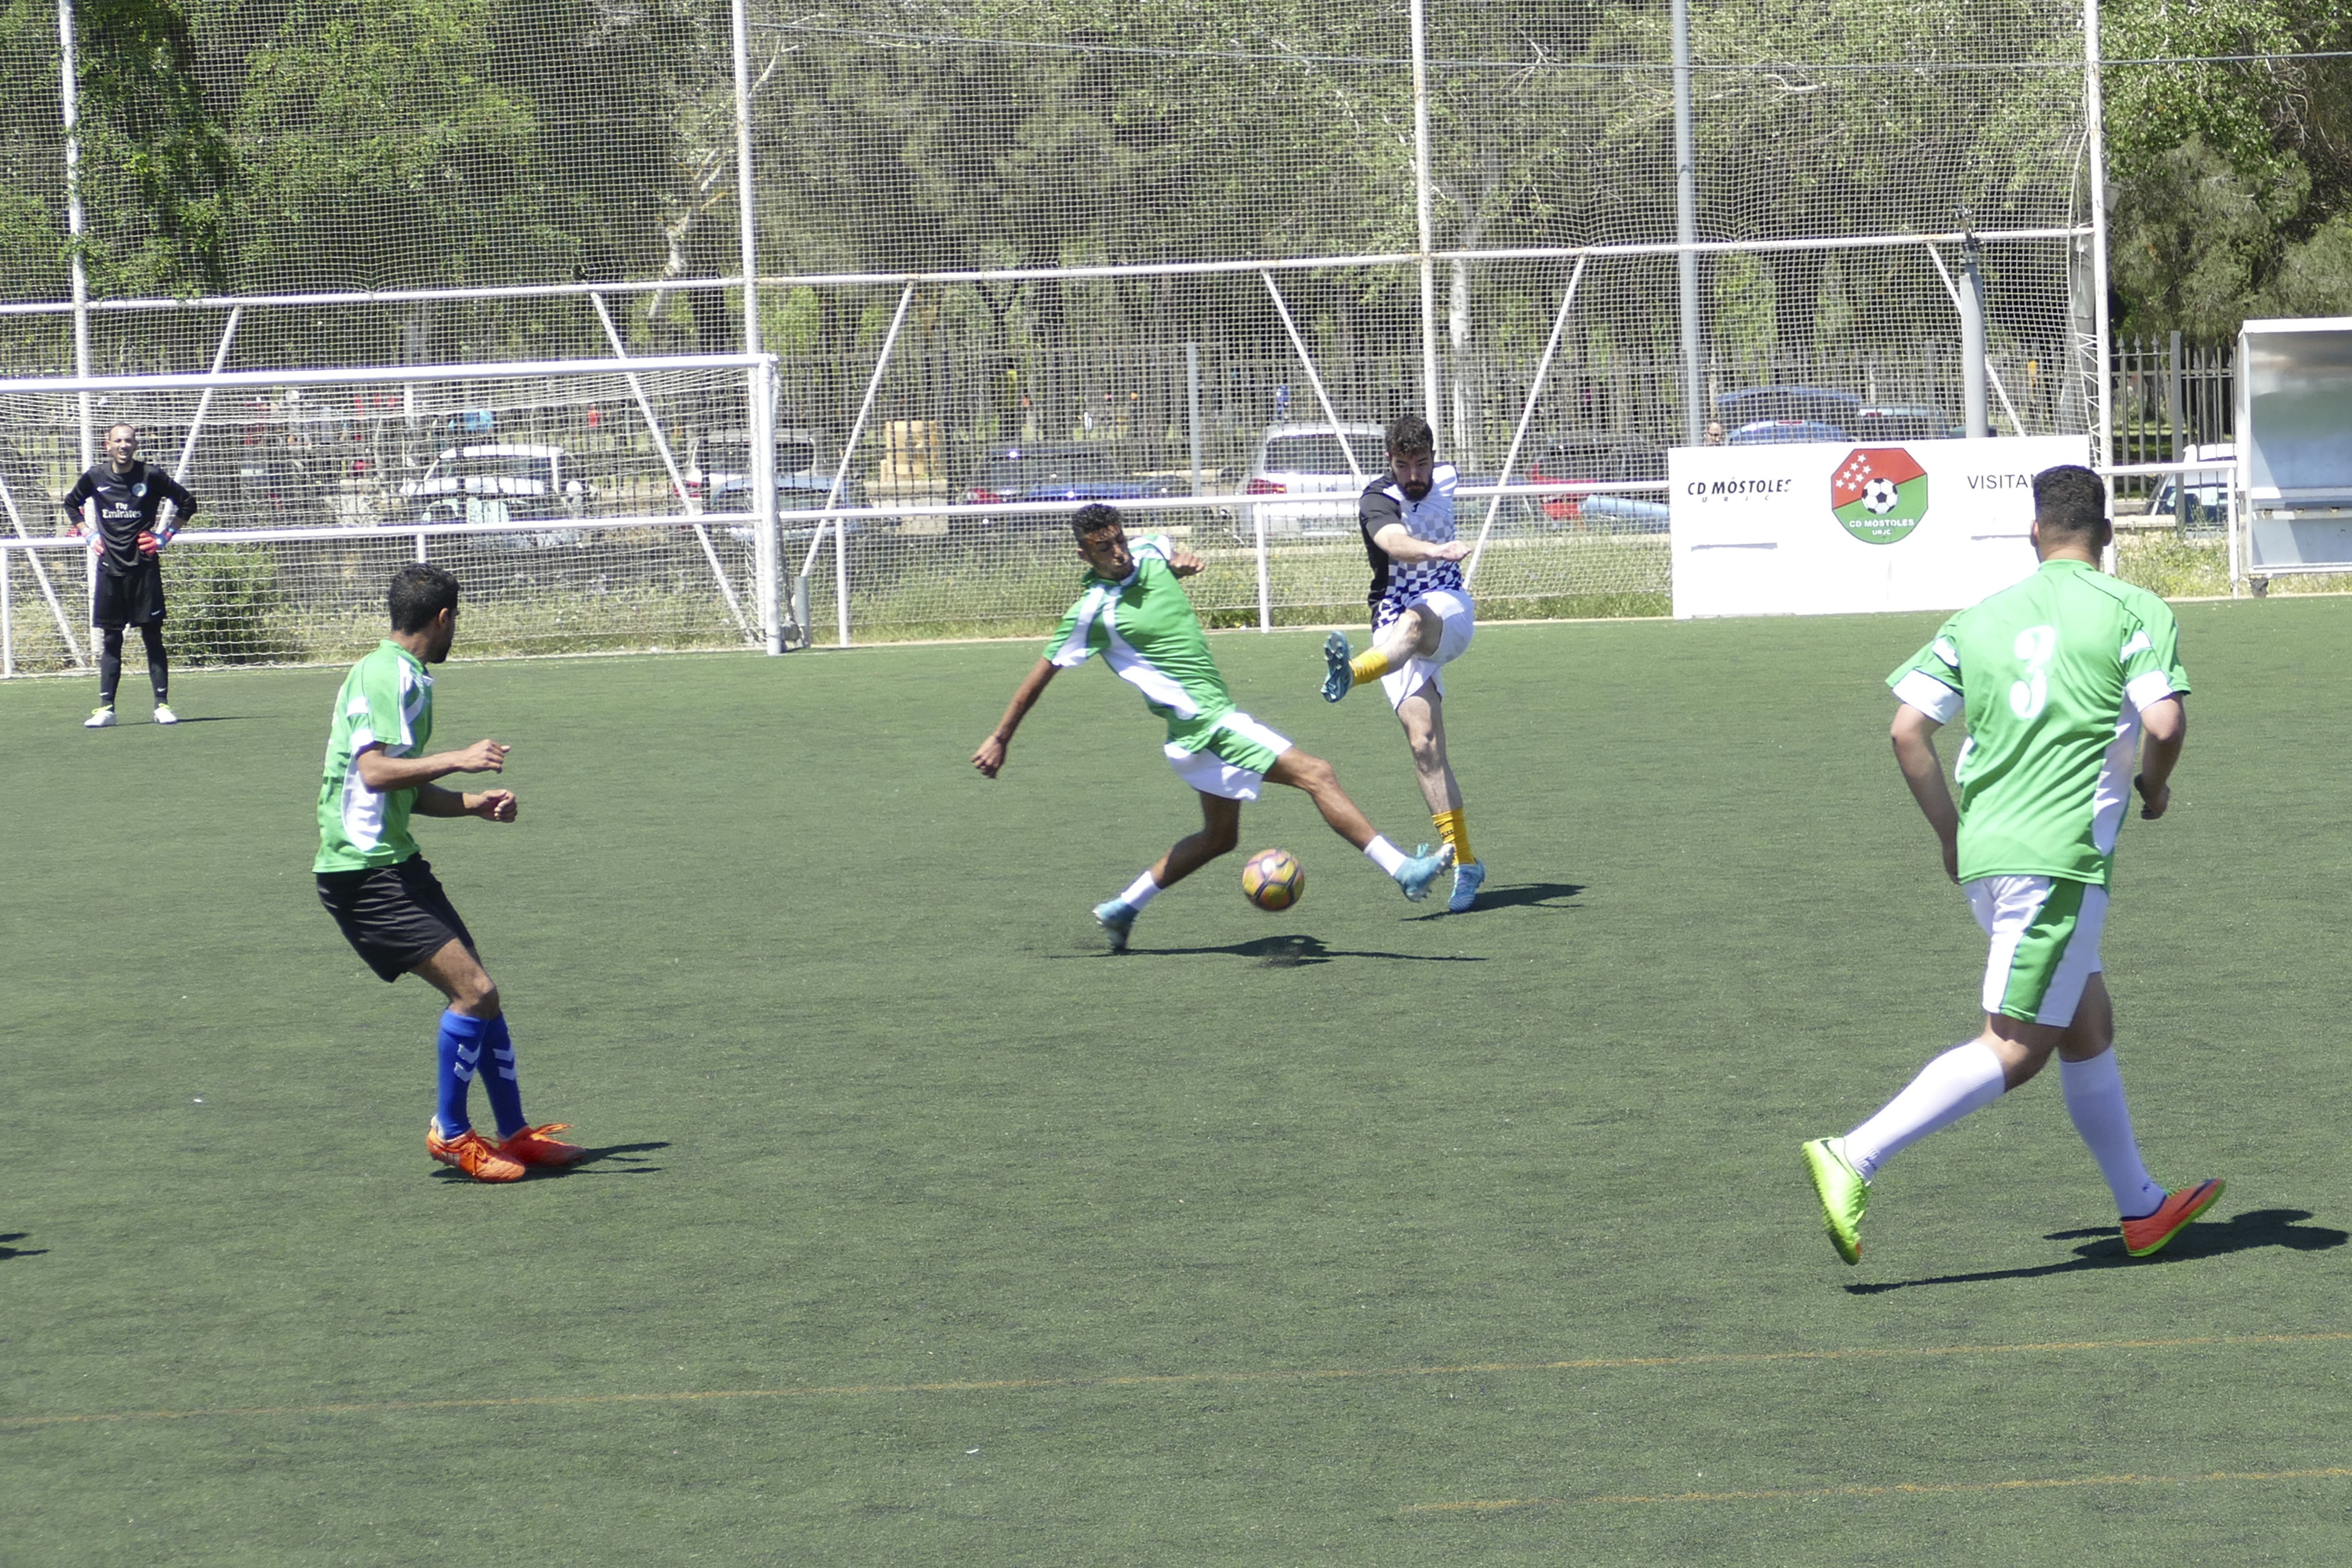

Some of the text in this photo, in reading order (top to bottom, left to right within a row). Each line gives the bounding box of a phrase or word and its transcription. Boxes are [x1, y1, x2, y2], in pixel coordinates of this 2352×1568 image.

[1687, 482, 1706, 495] CD
[102, 509, 142, 518] Emirates
[1864, 518, 1914, 527] MÓSTOLES
[2009, 625, 2056, 720] 3
